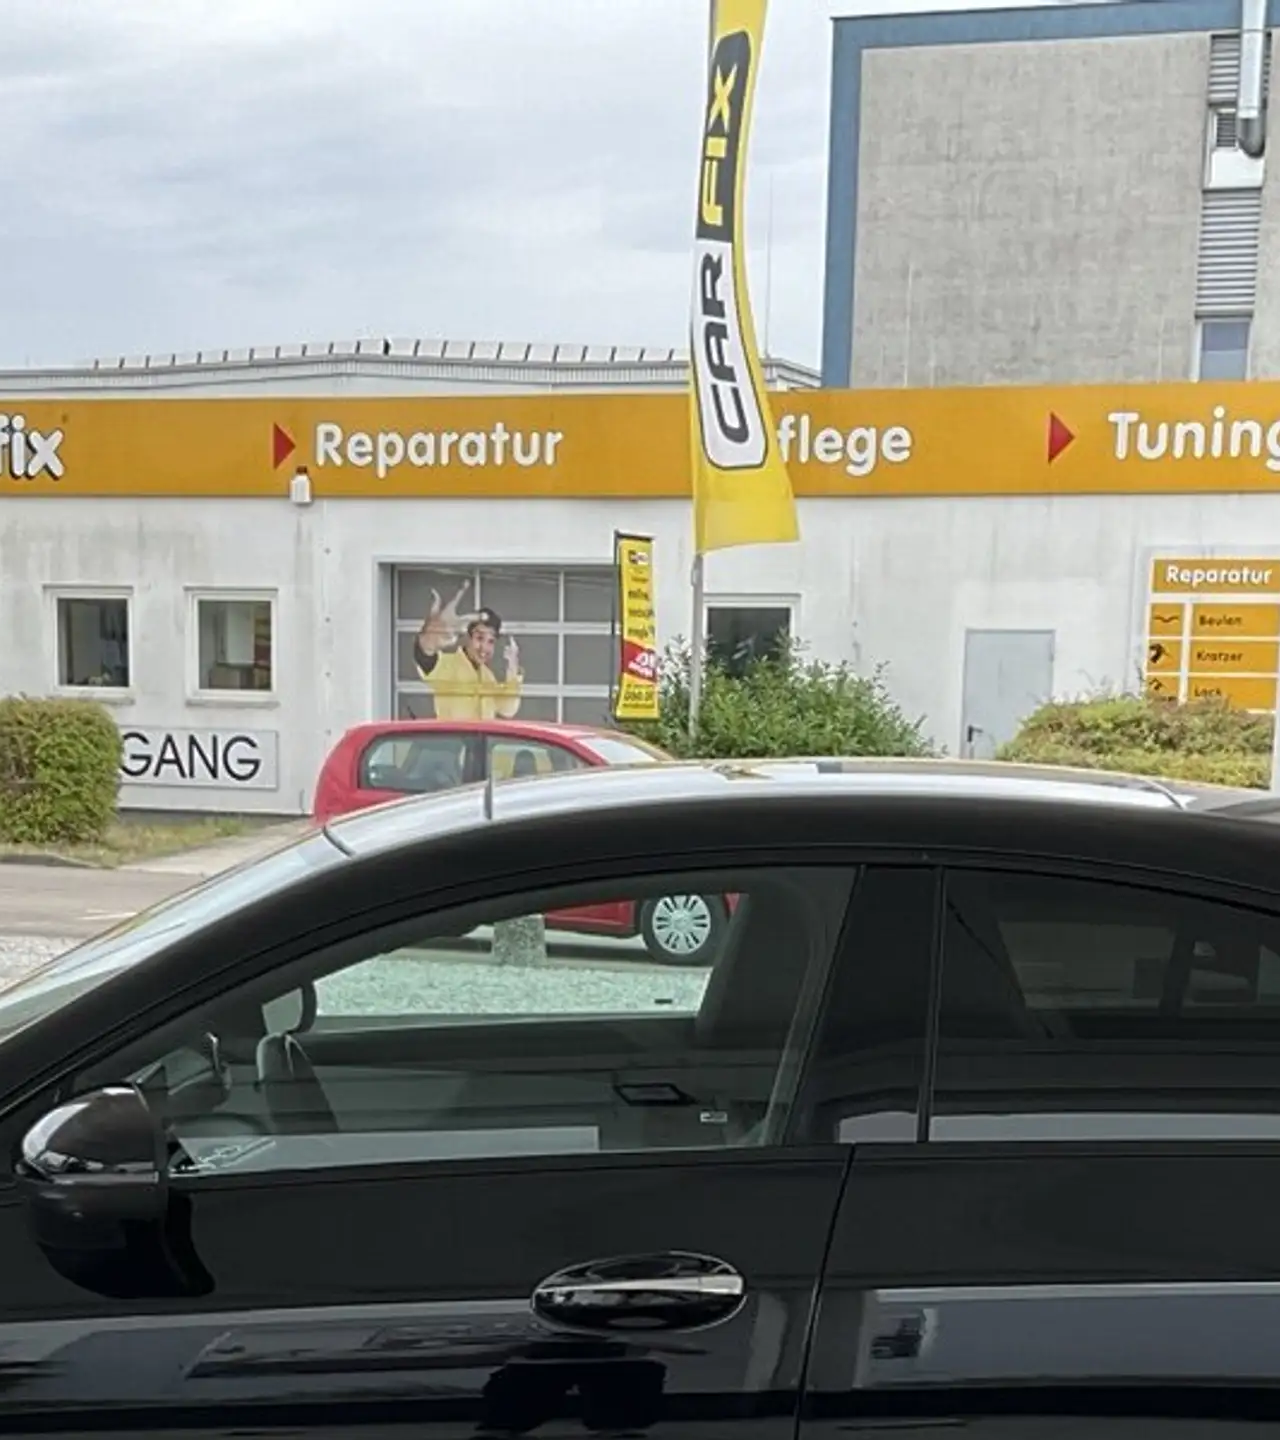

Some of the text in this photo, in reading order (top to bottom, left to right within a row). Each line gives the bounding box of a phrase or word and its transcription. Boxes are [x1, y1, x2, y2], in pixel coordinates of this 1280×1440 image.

[315, 421, 564, 479] Reparatur
[1165, 564, 1273, 588] Reparatur
[1199, 614, 1243, 627] Beulen
[1196, 649, 1244, 662] Kratzer
[120, 732, 262, 781] GANG
